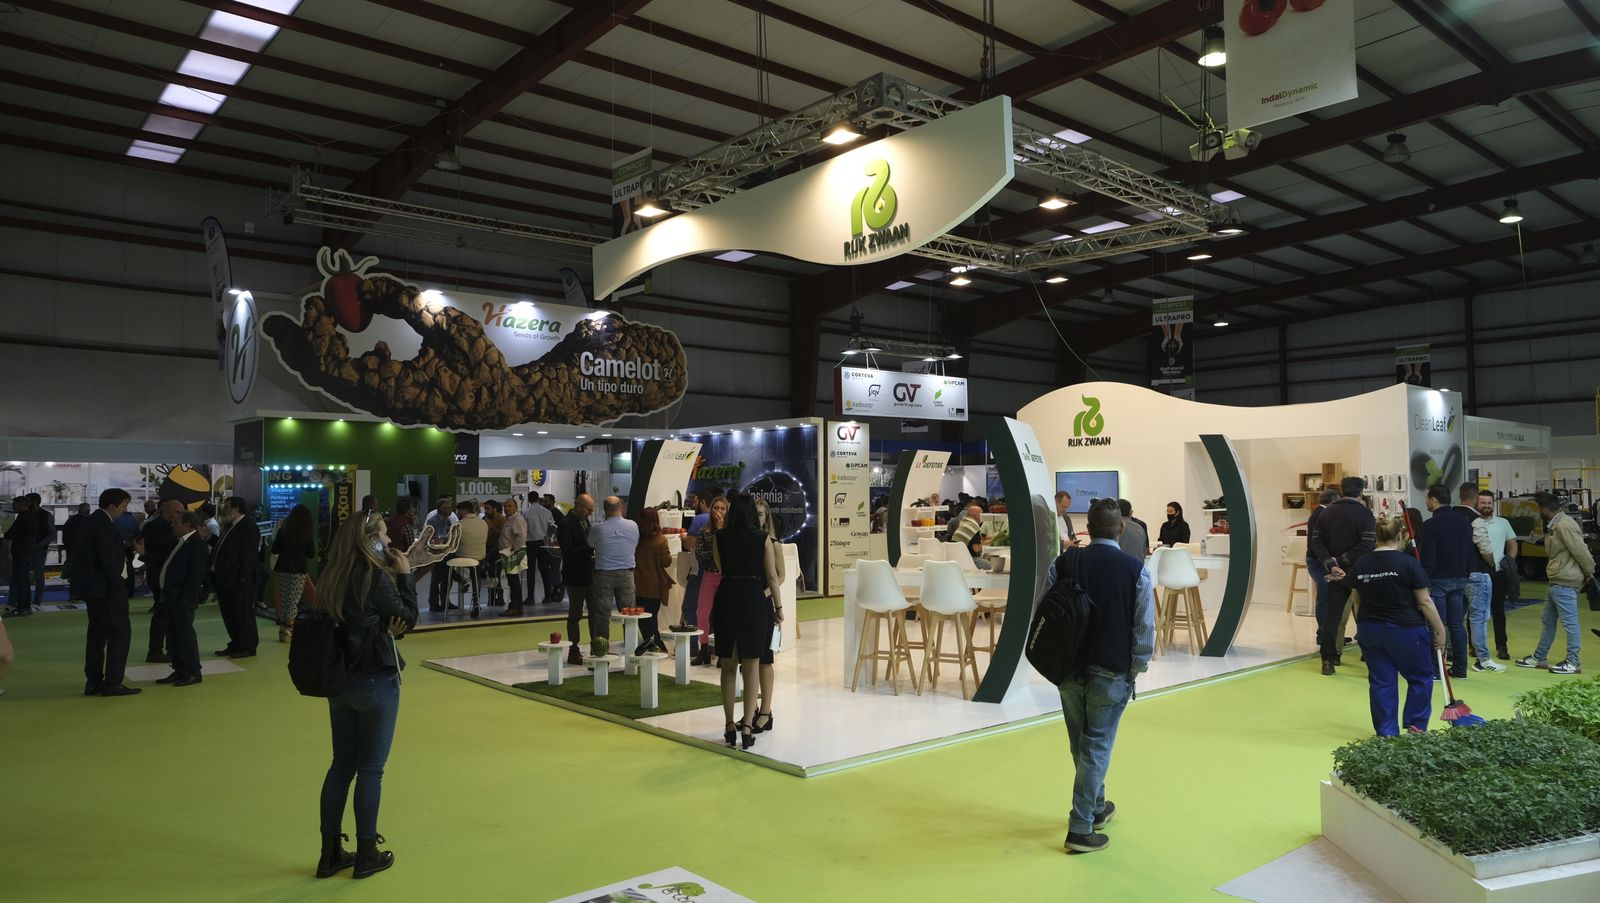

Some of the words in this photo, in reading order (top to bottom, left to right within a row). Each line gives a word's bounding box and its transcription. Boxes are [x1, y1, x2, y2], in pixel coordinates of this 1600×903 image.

[1261, 82, 1318, 104] IndalDynamic
[844, 236, 867, 259] RIJK
[868, 222, 910, 252] ZWAAN
[481, 302, 561, 333] Hazera
[1155, 313, 1191, 323] ULTRAPRO
[513, 331, 531, 339] Seeds
[580, 351, 661, 381] Camelot
[580, 379, 594, 391] Un
[597, 380, 617, 395] tipo
[620, 381, 643, 394] duro
[1414, 413, 1447, 432] CleanLeaf
[1068, 438, 1083, 447] RIJK
[1085, 436, 1111, 446] ZWAAN
